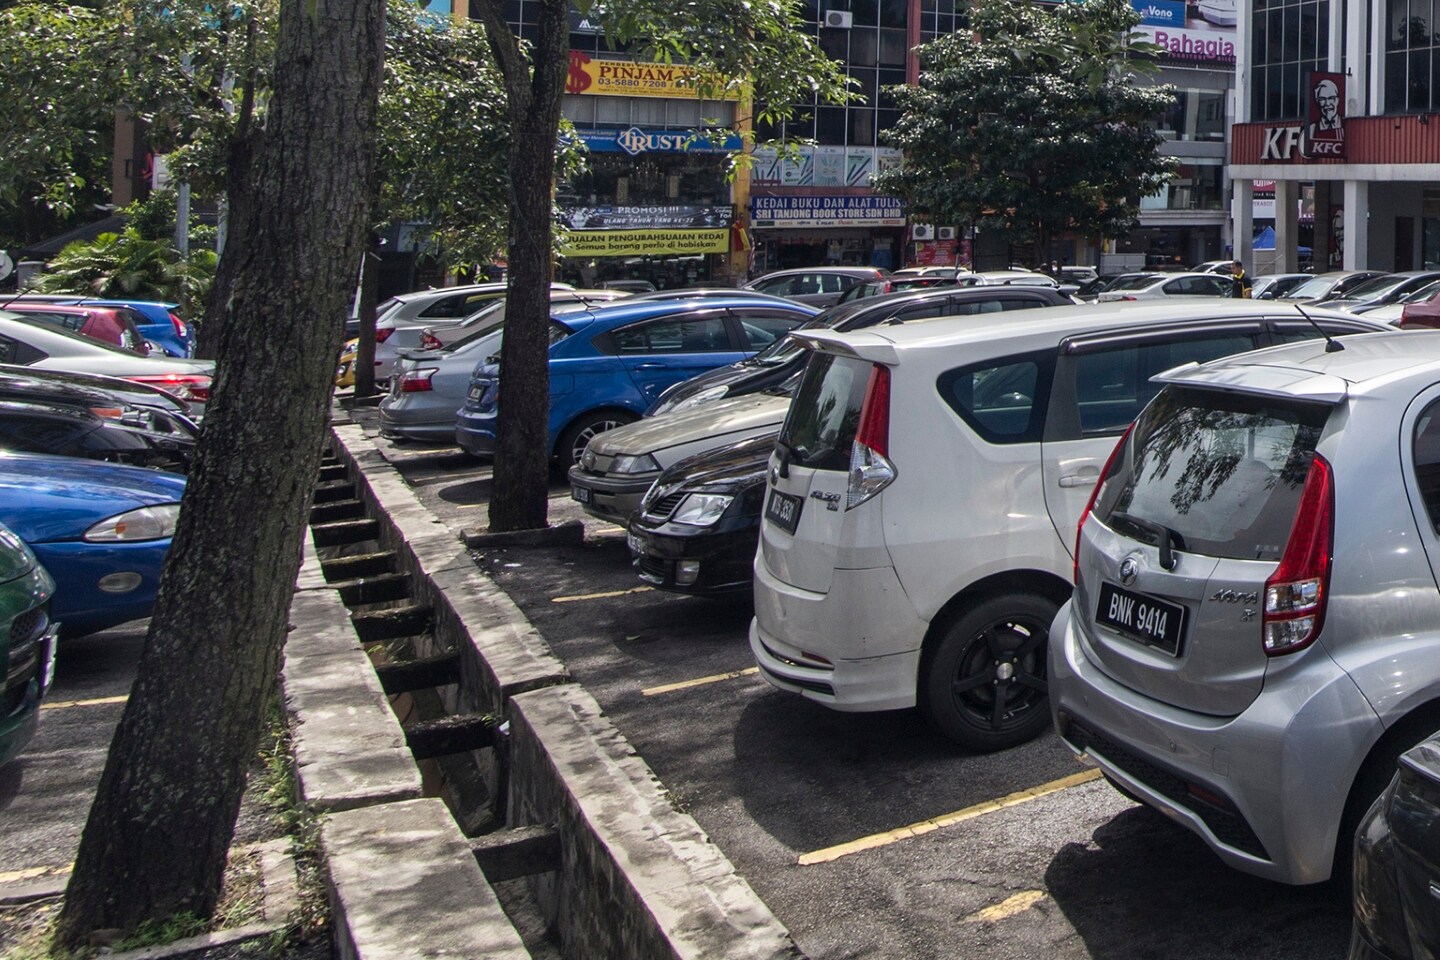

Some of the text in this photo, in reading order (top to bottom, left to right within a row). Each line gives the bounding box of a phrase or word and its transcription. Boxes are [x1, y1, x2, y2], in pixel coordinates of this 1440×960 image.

[1148, 5, 1173, 17] Vono
[1155, 31, 1234, 59] Bahagia
[600, 66, 674, 81] PINJAM
[643, 80, 666, 88] 7208
[620, 131, 686, 152] TRUST
[1312, 142, 1342, 154] KFC
[756, 197, 901, 208] KEDAI BUKU DAN ALAT TULIS
[618, 206, 667, 214] PROMOSI
[756, 209, 901, 219] SRI TANJONG BOOK STORE SDN BHD
[608, 234, 695, 242] PENGUBAHSUAIAN
[643, 241, 665, 249] perlu
[677, 240, 716, 248] habiskan
[1108, 593, 1168, 639] BNK 9414
